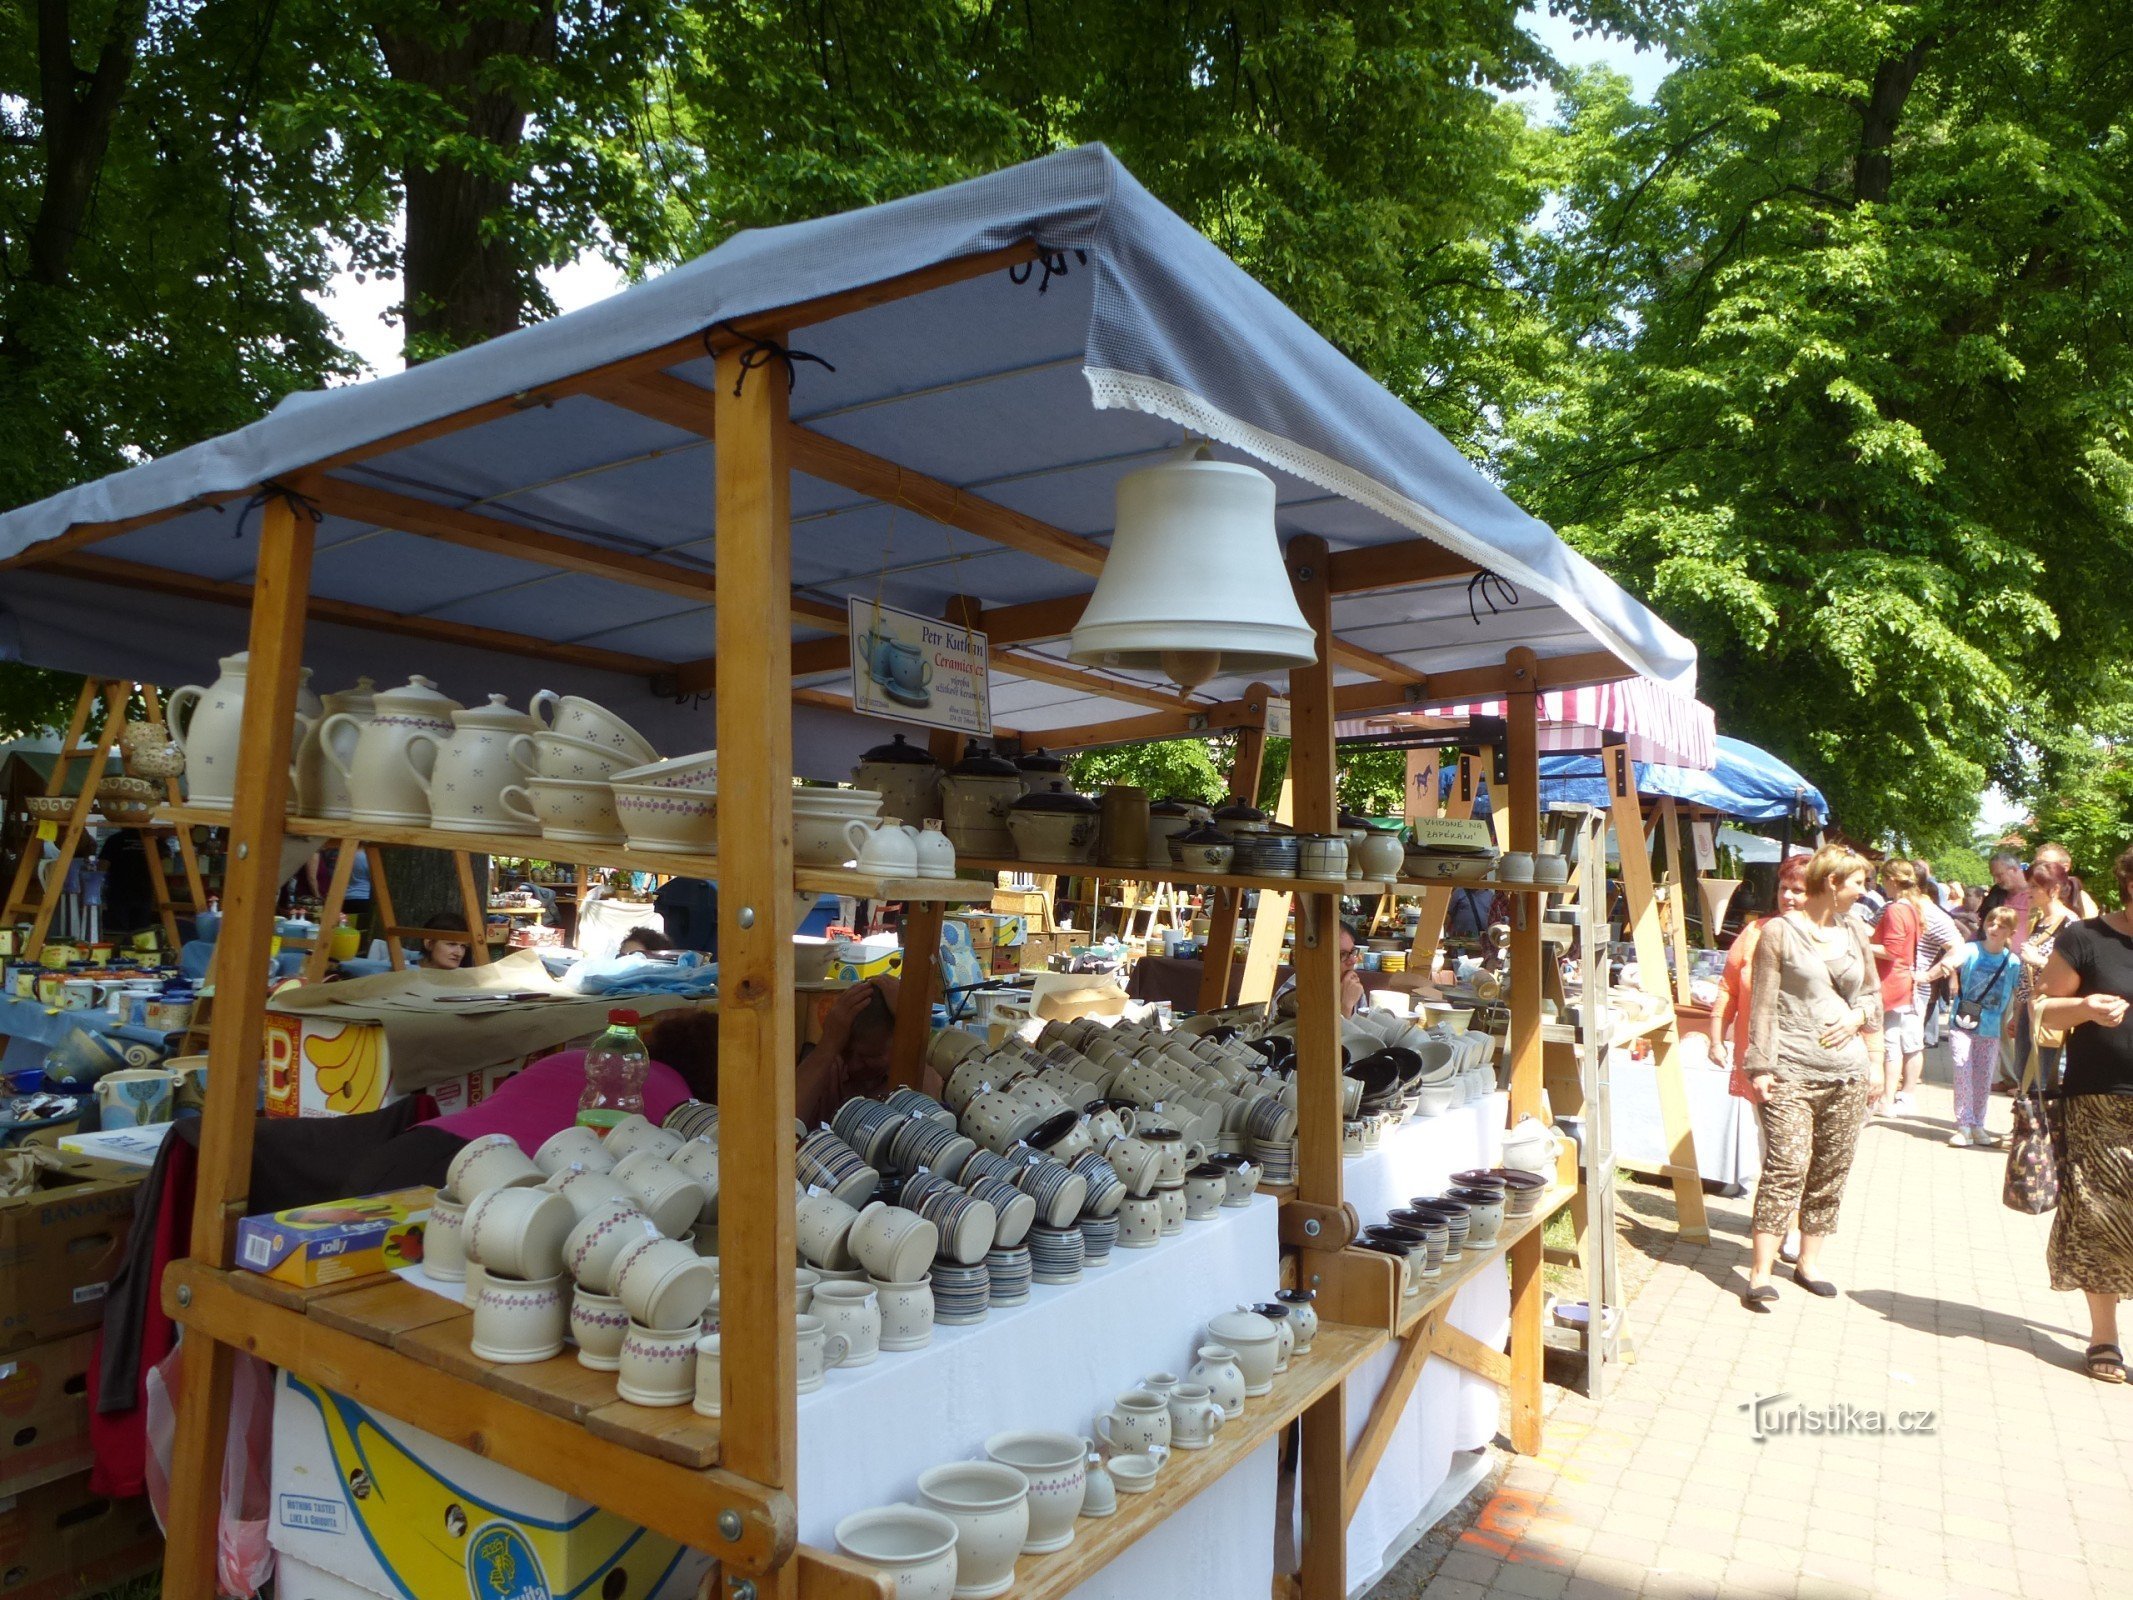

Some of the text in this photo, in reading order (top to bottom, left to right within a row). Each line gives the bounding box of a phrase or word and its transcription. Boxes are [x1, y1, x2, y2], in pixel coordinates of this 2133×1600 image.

[922, 626, 942, 646] Petr
[1424, 818, 1483, 830] VHODNÉ NA
[318, 1238, 348, 1255] Jolly
[313, 1503, 336, 1514] TASTES
[289, 1513, 337, 1528] LIKE A CHIQUITA
